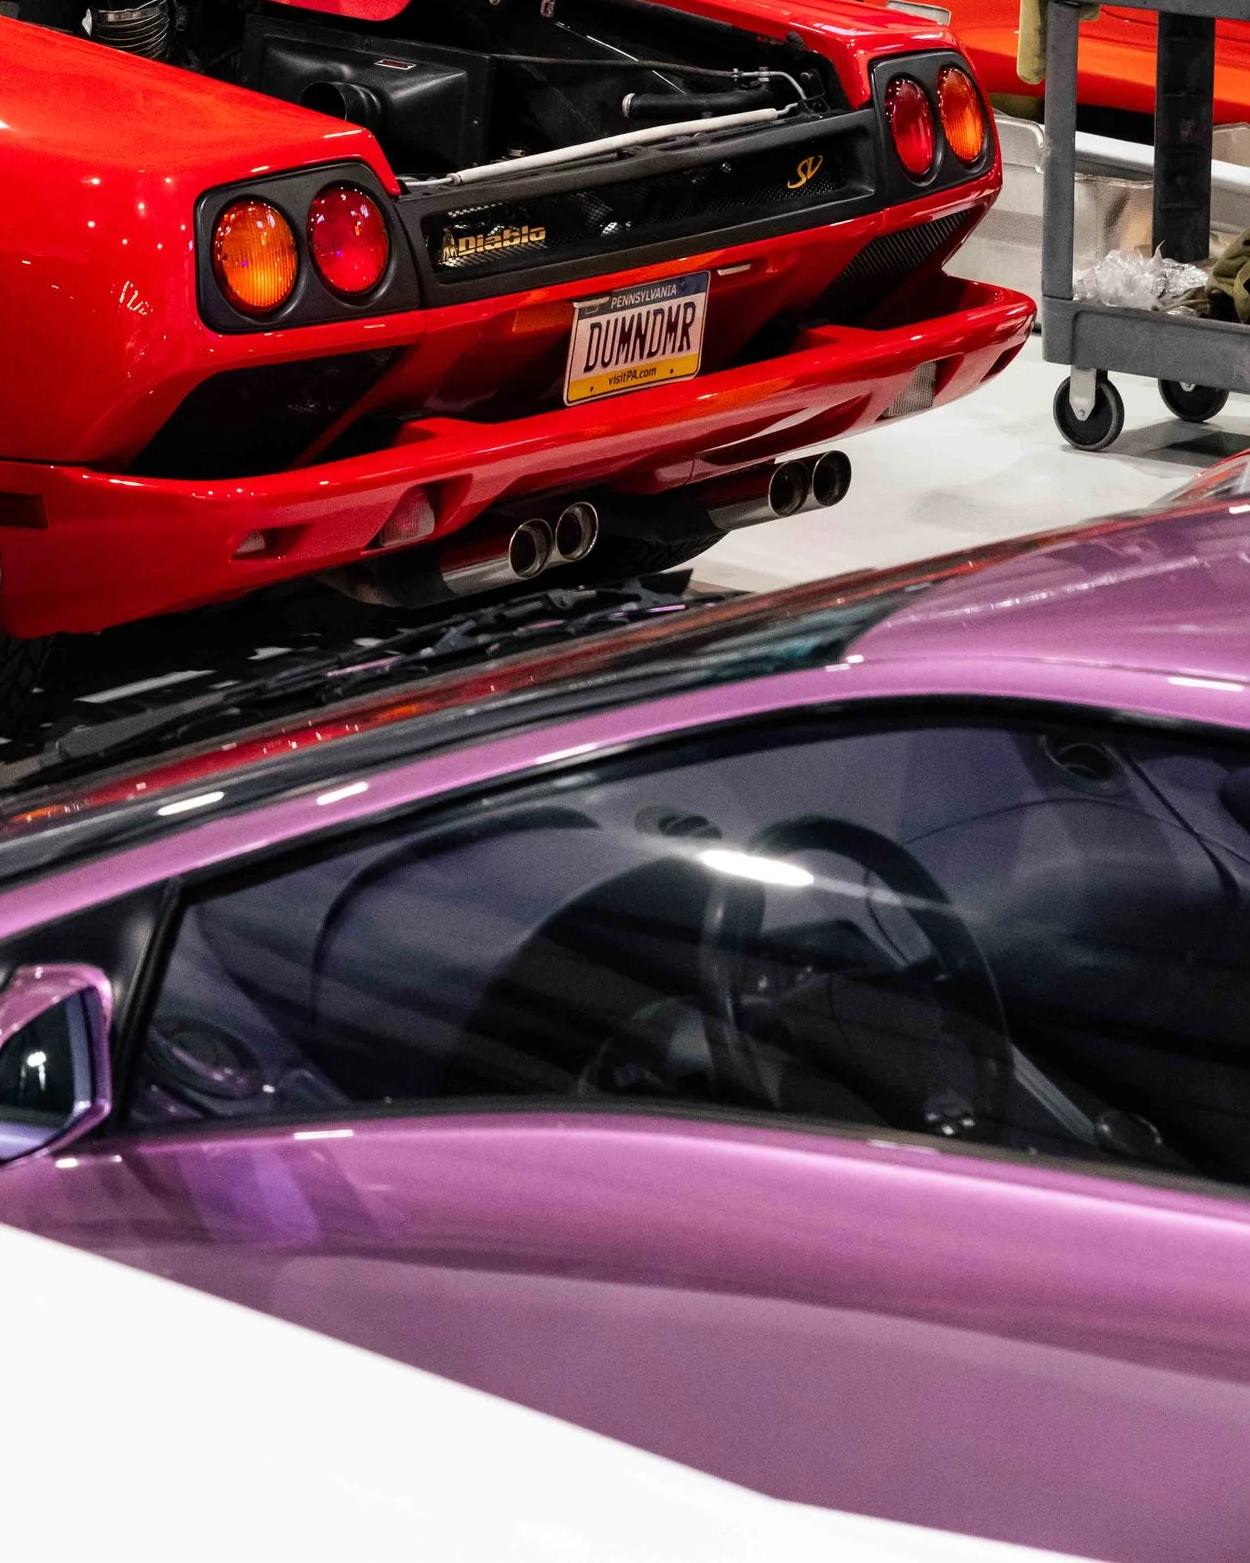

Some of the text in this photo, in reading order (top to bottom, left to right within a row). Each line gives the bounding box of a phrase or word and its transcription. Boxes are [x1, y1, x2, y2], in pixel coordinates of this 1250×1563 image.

[787, 155, 823, 189] SV
[458, 225, 546, 257] Diablo
[610, 284, 677, 309] PENNSYLVANIA
[583, 301, 696, 373] DUMNDMR
[608, 366, 657, 386] visitPA.com
